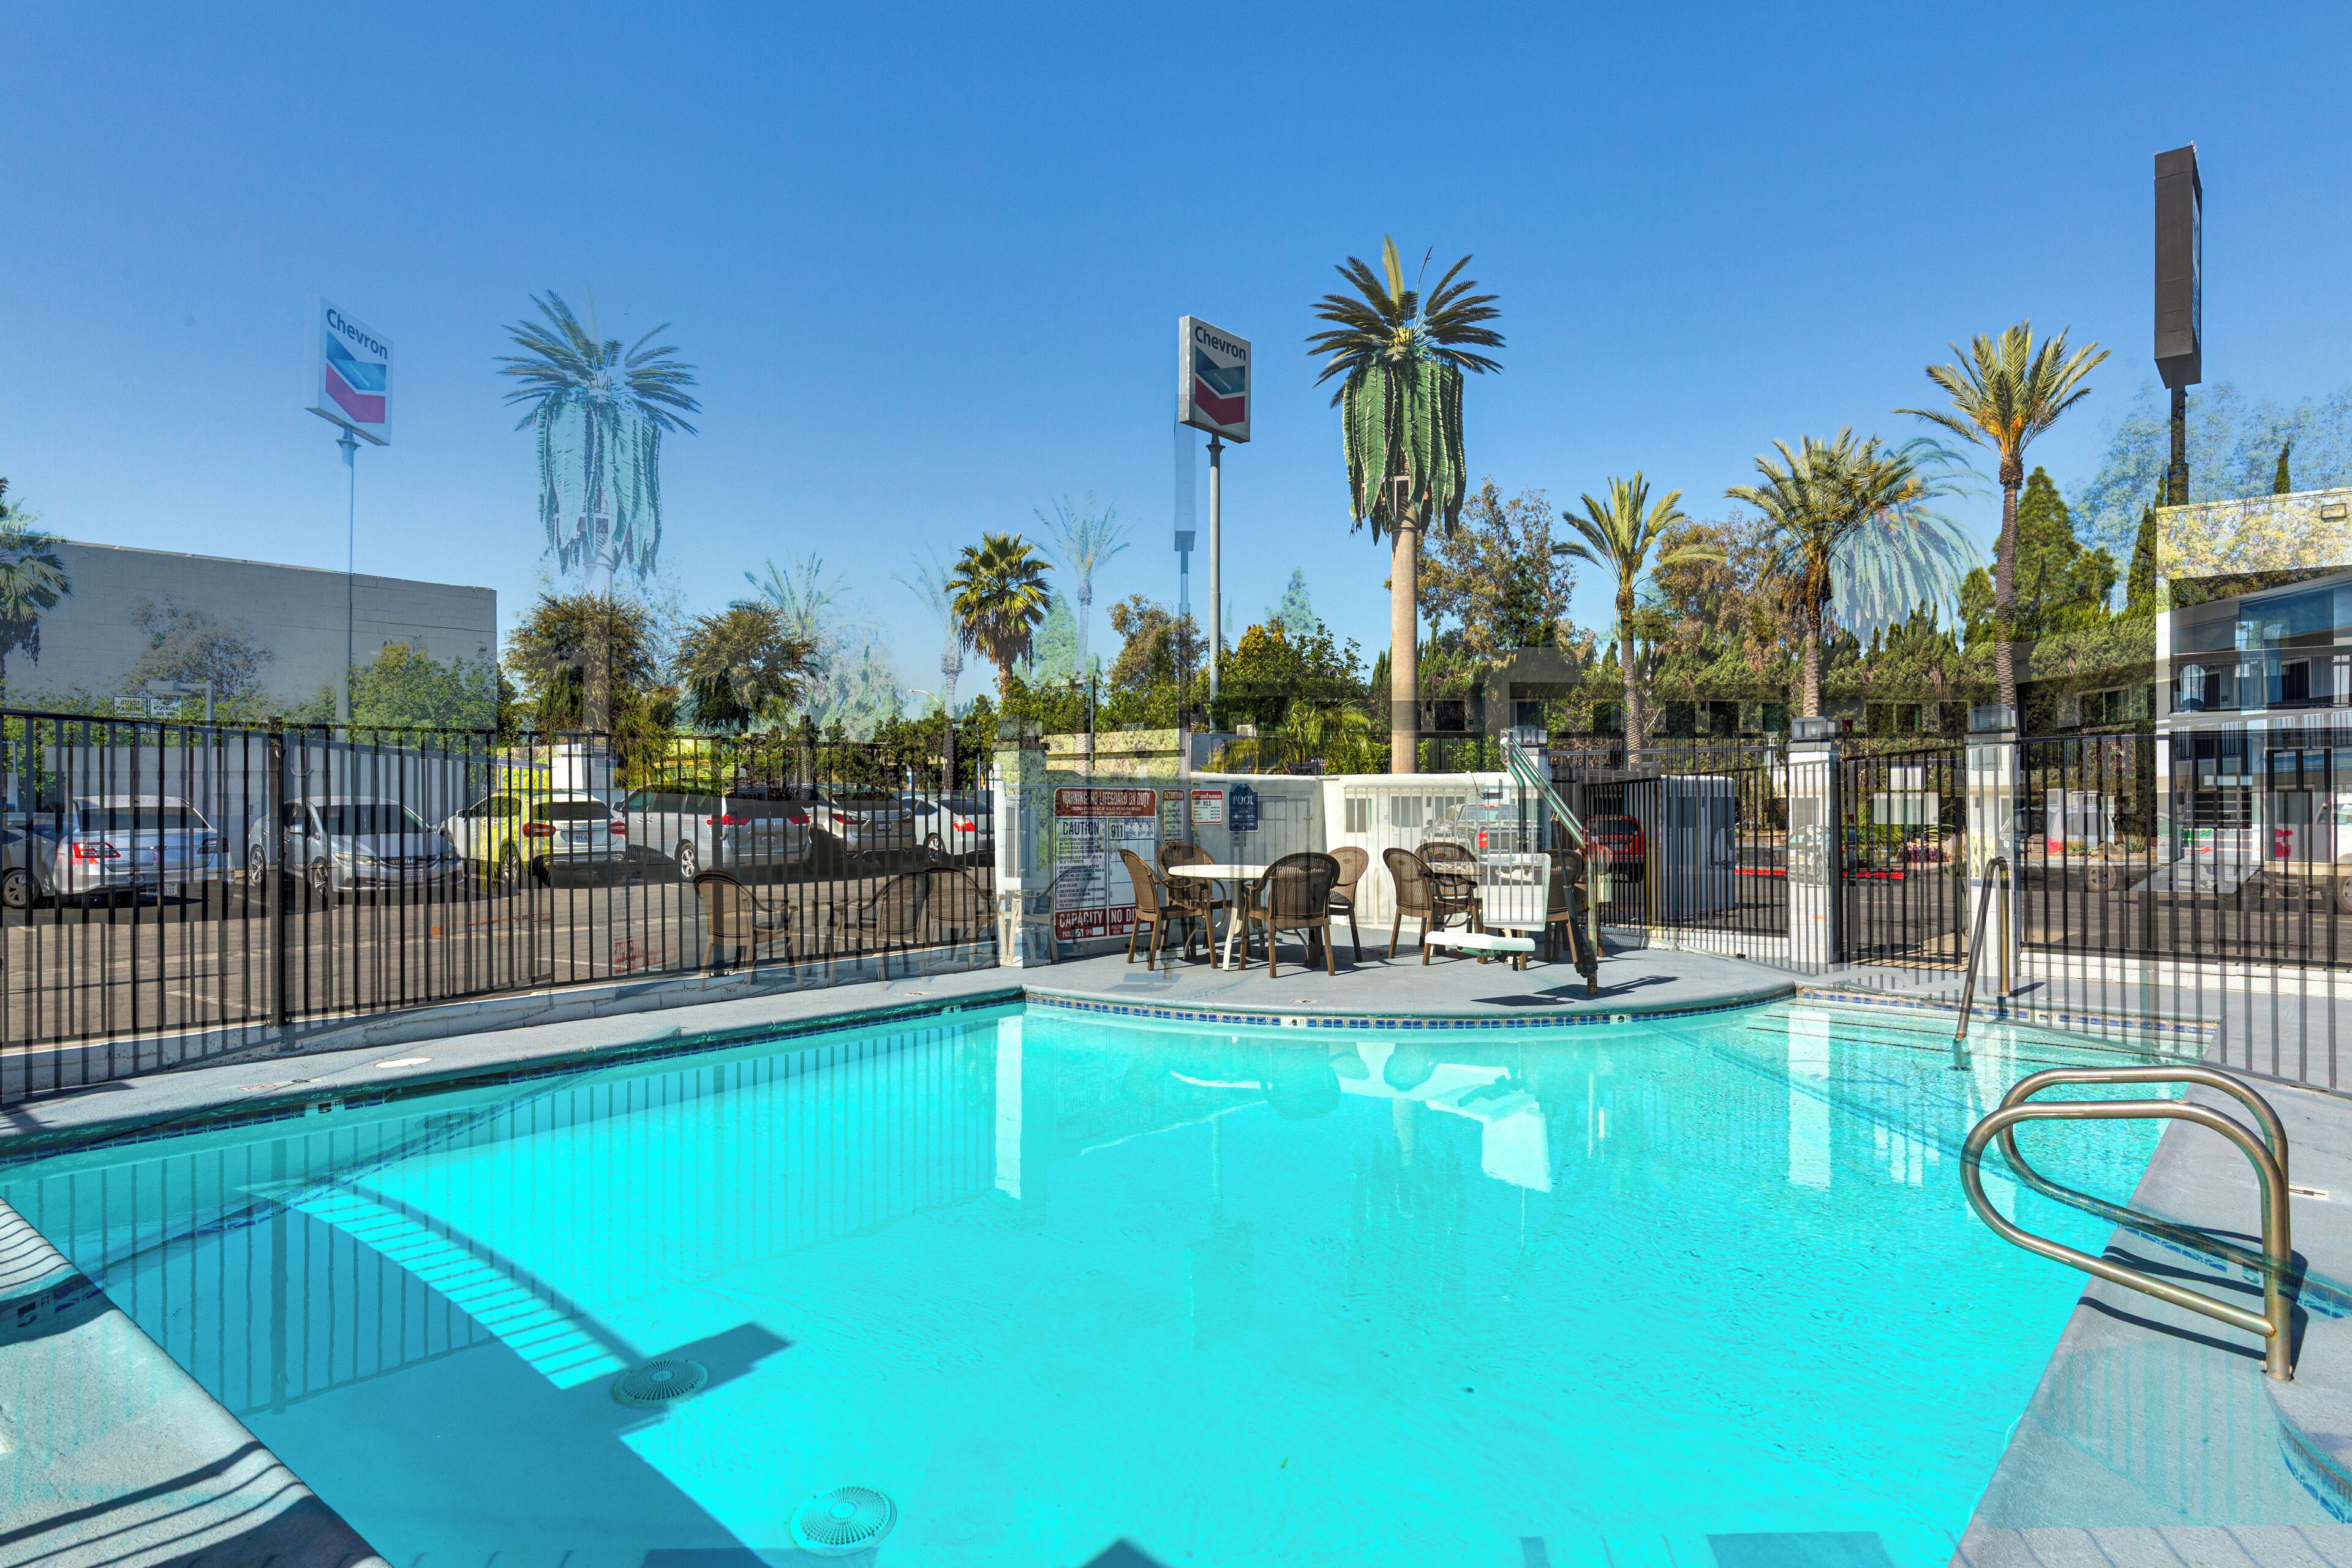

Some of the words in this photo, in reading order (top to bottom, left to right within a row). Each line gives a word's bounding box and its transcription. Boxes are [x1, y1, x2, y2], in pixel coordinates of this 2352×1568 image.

[326, 308, 388, 360] Chevron
[1194, 325, 1246, 362] Chevron
[1090, 791, 1098, 805] NO
[1099, 791, 1128, 805] LIFEGUARD
[1137, 792, 1150, 806] DUTY
[1233, 795, 1254, 805] POOL
[1063, 821, 1099, 835] CAUTION
[1110, 824, 1123, 838] 911
[1059, 911, 1103, 928] CAPACITY
[1111, 909, 1122, 923] NO
[317, 1102, 333, 1114] 5
[2264, 1270, 2272, 1280] FT
[17, 1301, 37, 1328] 5
[41, 1295, 51, 1308] FT
